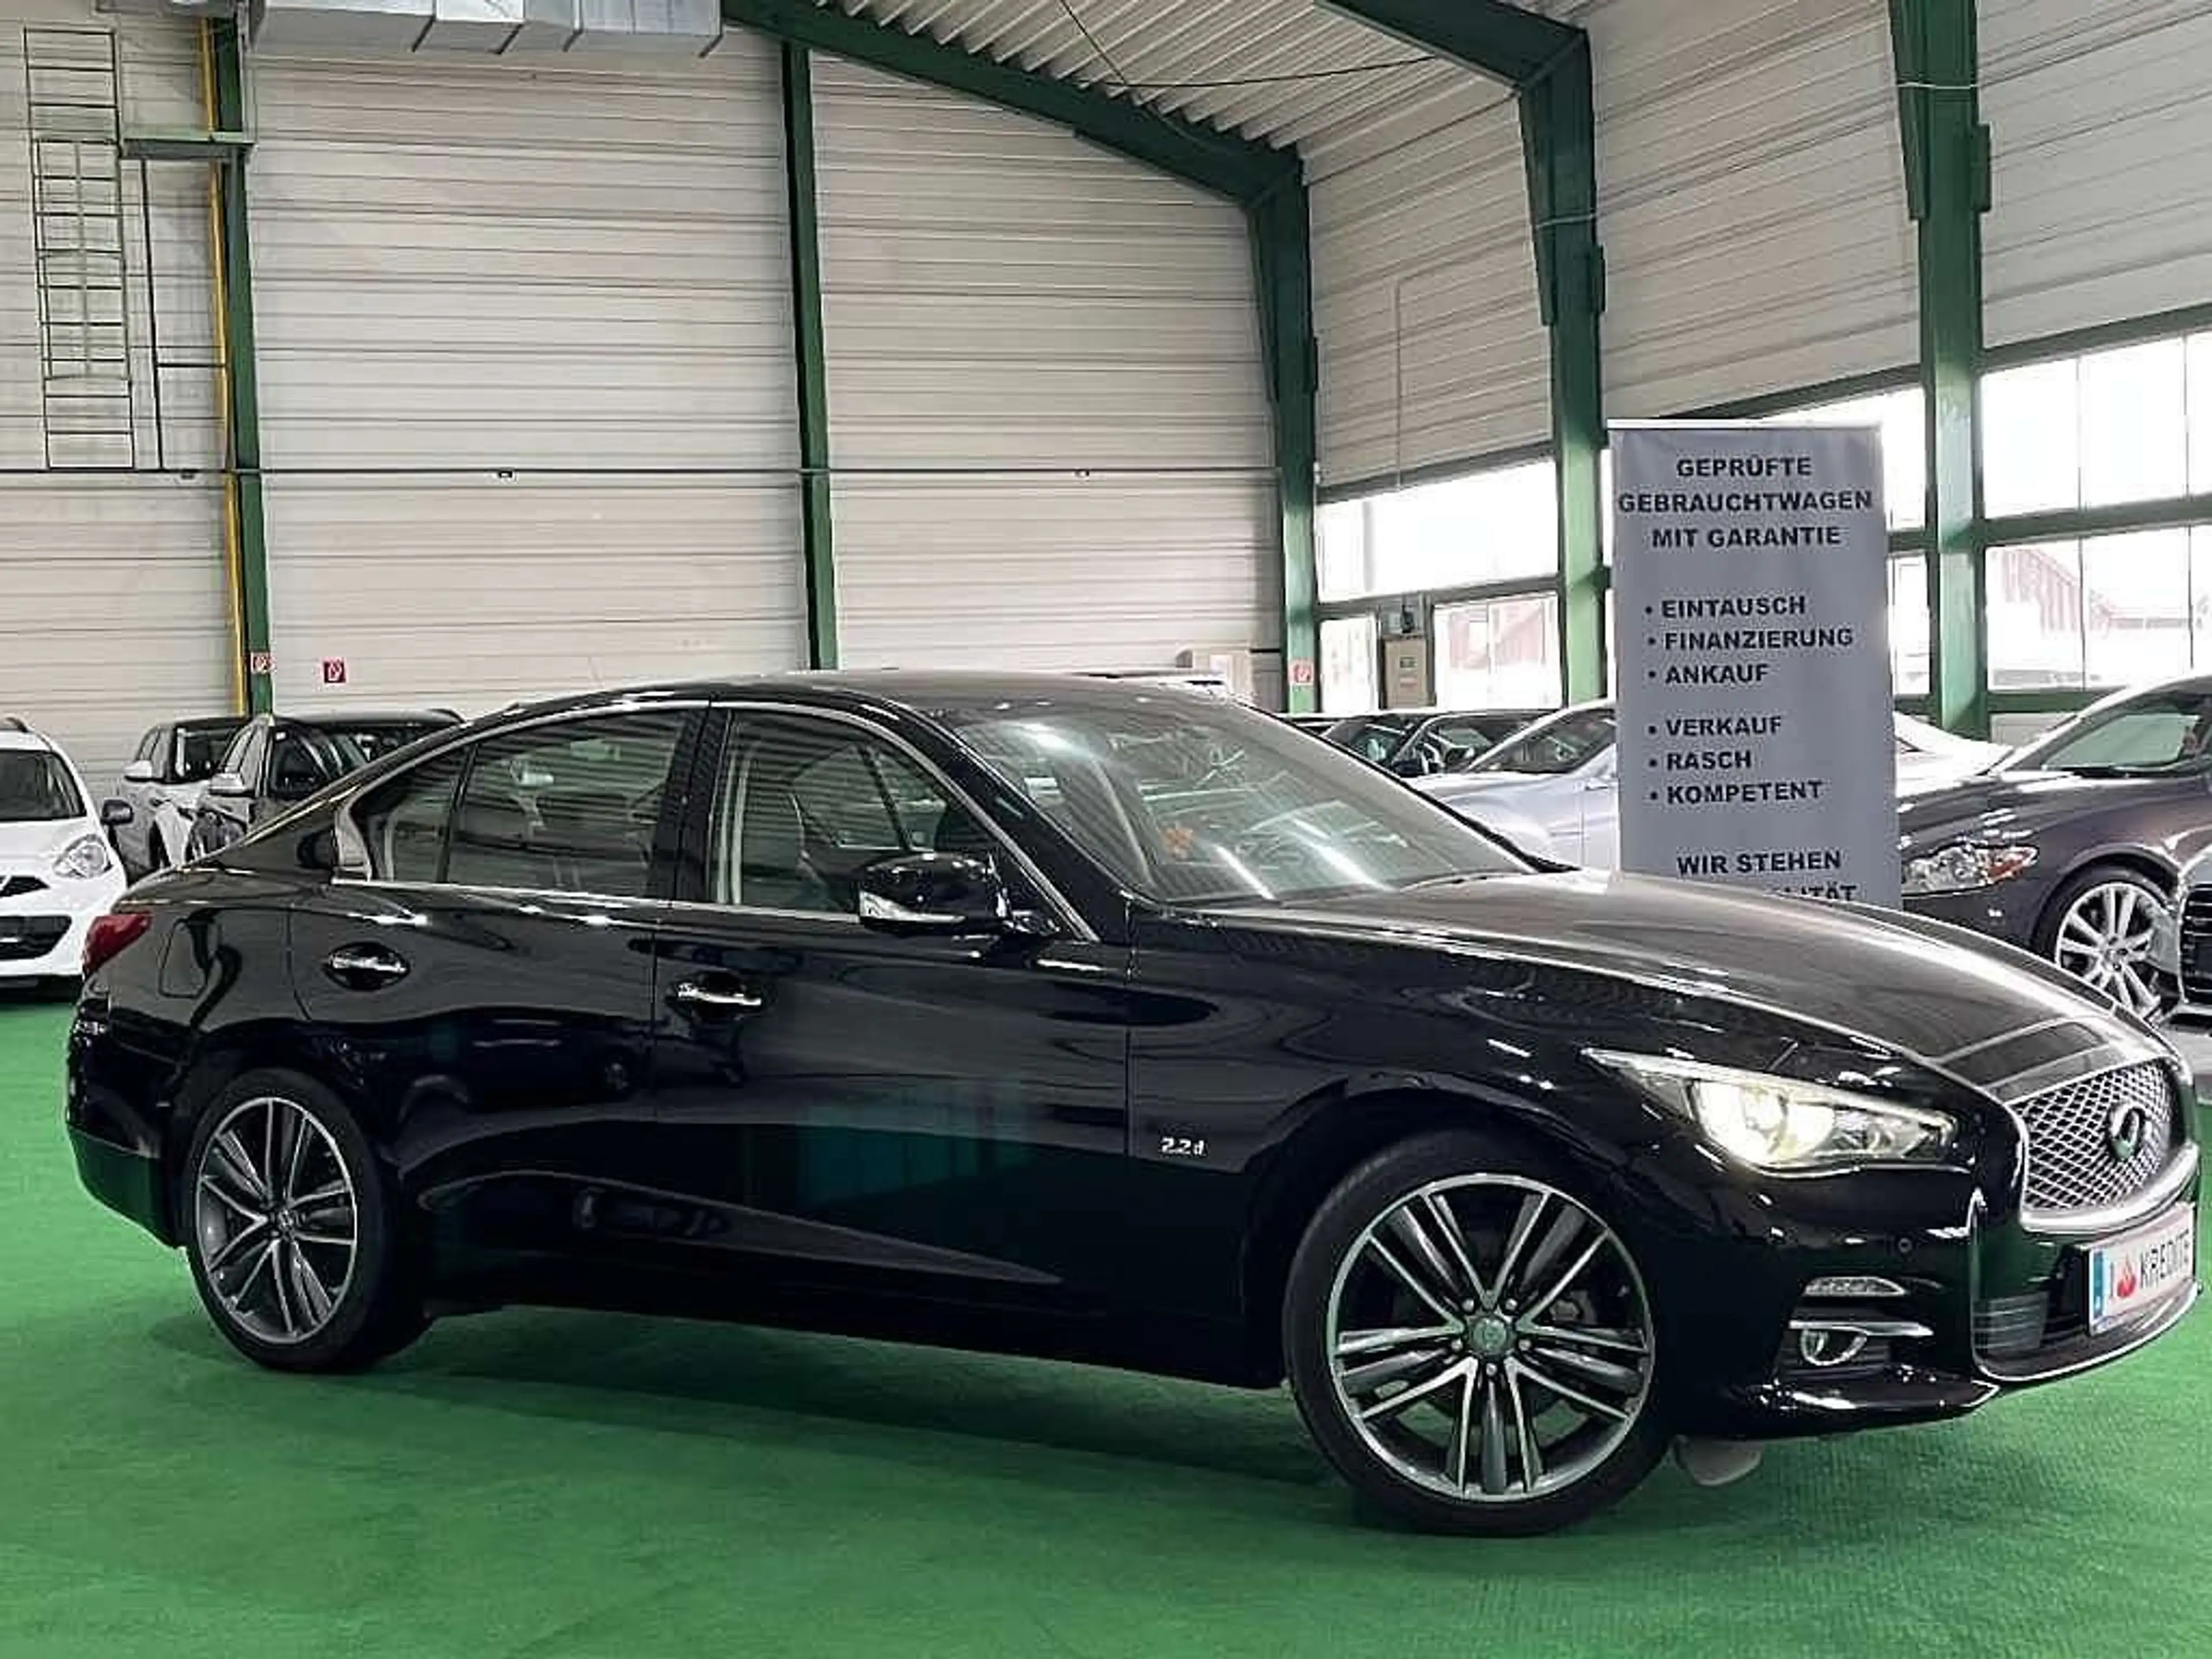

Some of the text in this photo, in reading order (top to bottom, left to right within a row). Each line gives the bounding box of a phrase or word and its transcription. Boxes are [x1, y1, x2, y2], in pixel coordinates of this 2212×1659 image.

[1677, 454, 1812, 477] GEPRÜFTE
[1619, 490, 1872, 513] GEBRAUCHTWAGEN
[1652, 527, 1841, 547] MIT GARANTIE
[1662, 596, 1805, 619] EINTAUSCH
[1665, 628, 1854, 650] FINANZIERUNG
[1665, 664, 1769, 684] ANKAUF
[1666, 716, 1782, 737] VERKAUF
[1667, 751, 1752, 771] RASCH
[1668, 781, 1823, 804] KOMPETENT
[1677, 850, 1841, 876] WIR STEHEN
[2139, 1228, 2190, 1289] KREDITE
